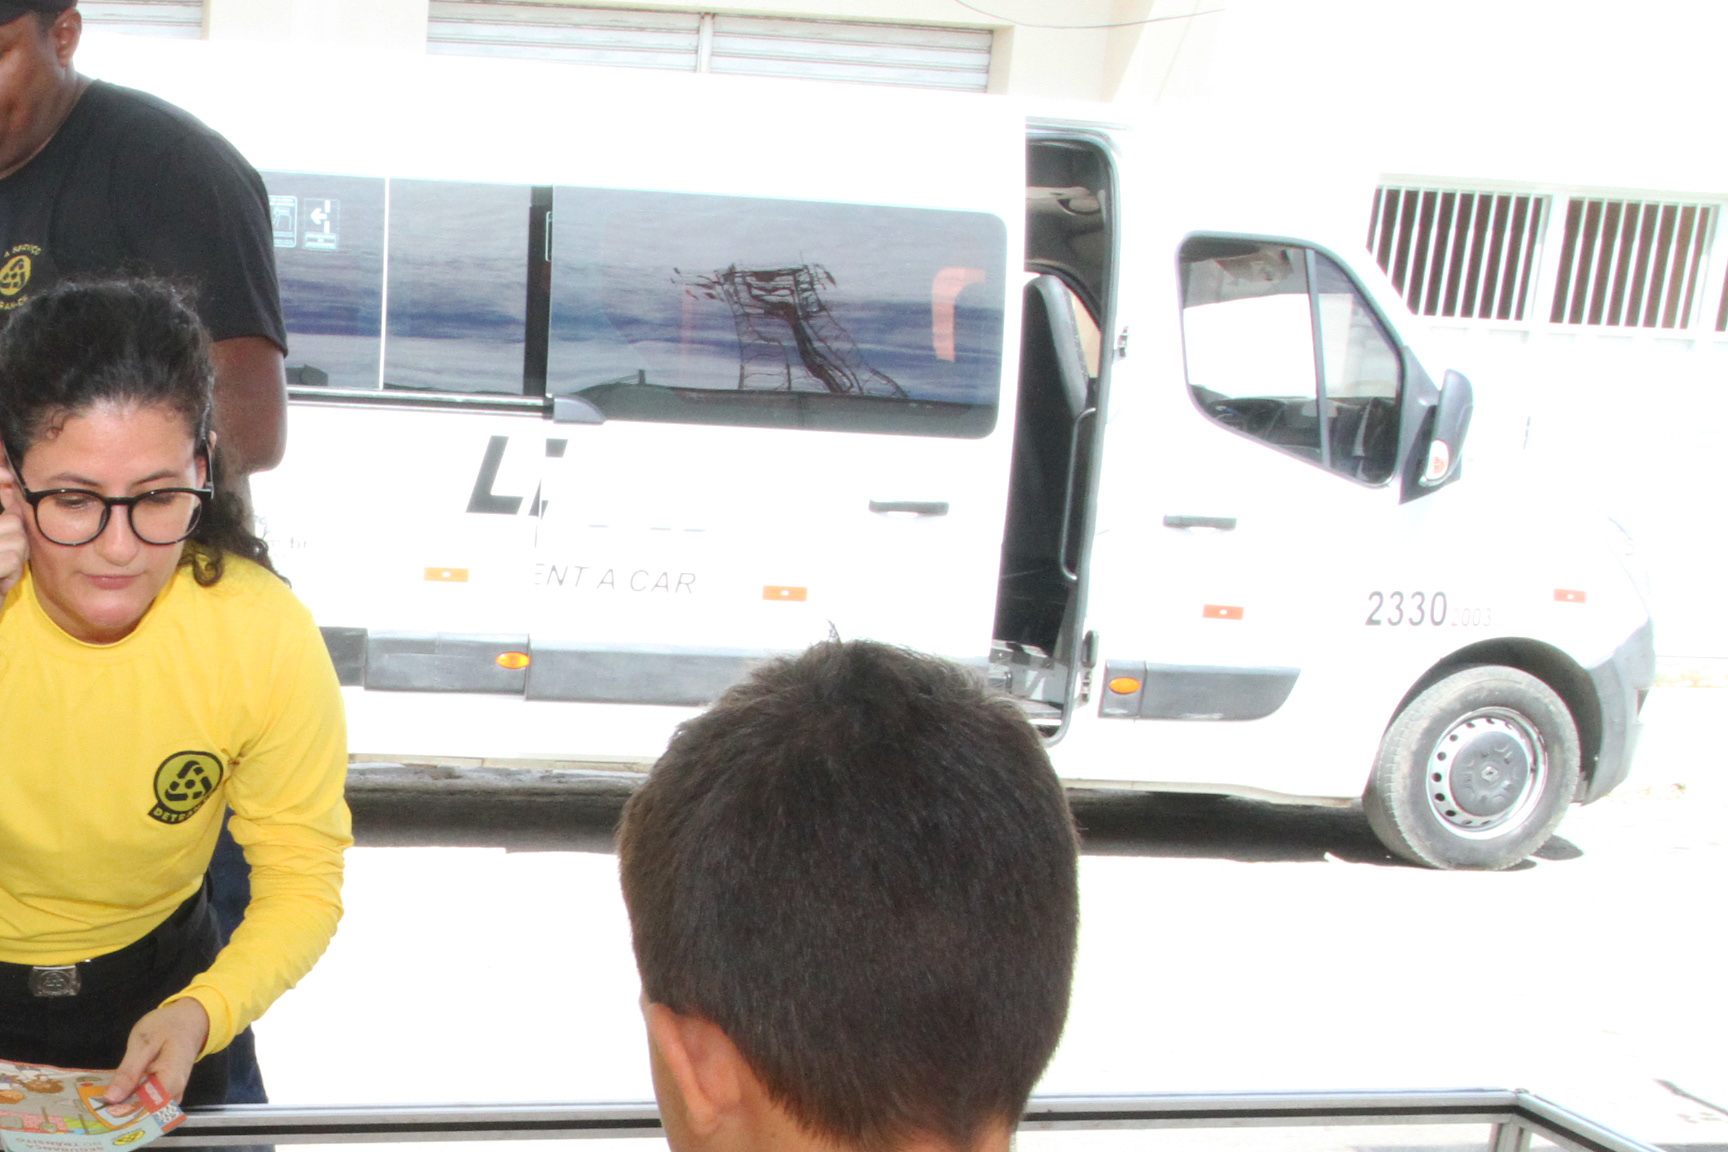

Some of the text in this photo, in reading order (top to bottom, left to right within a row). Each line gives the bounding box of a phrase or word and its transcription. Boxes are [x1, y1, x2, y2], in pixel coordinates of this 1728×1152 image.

[597, 568, 616, 590] A
[629, 569, 697, 595] CAR
[1364, 590, 1448, 627] 2330
